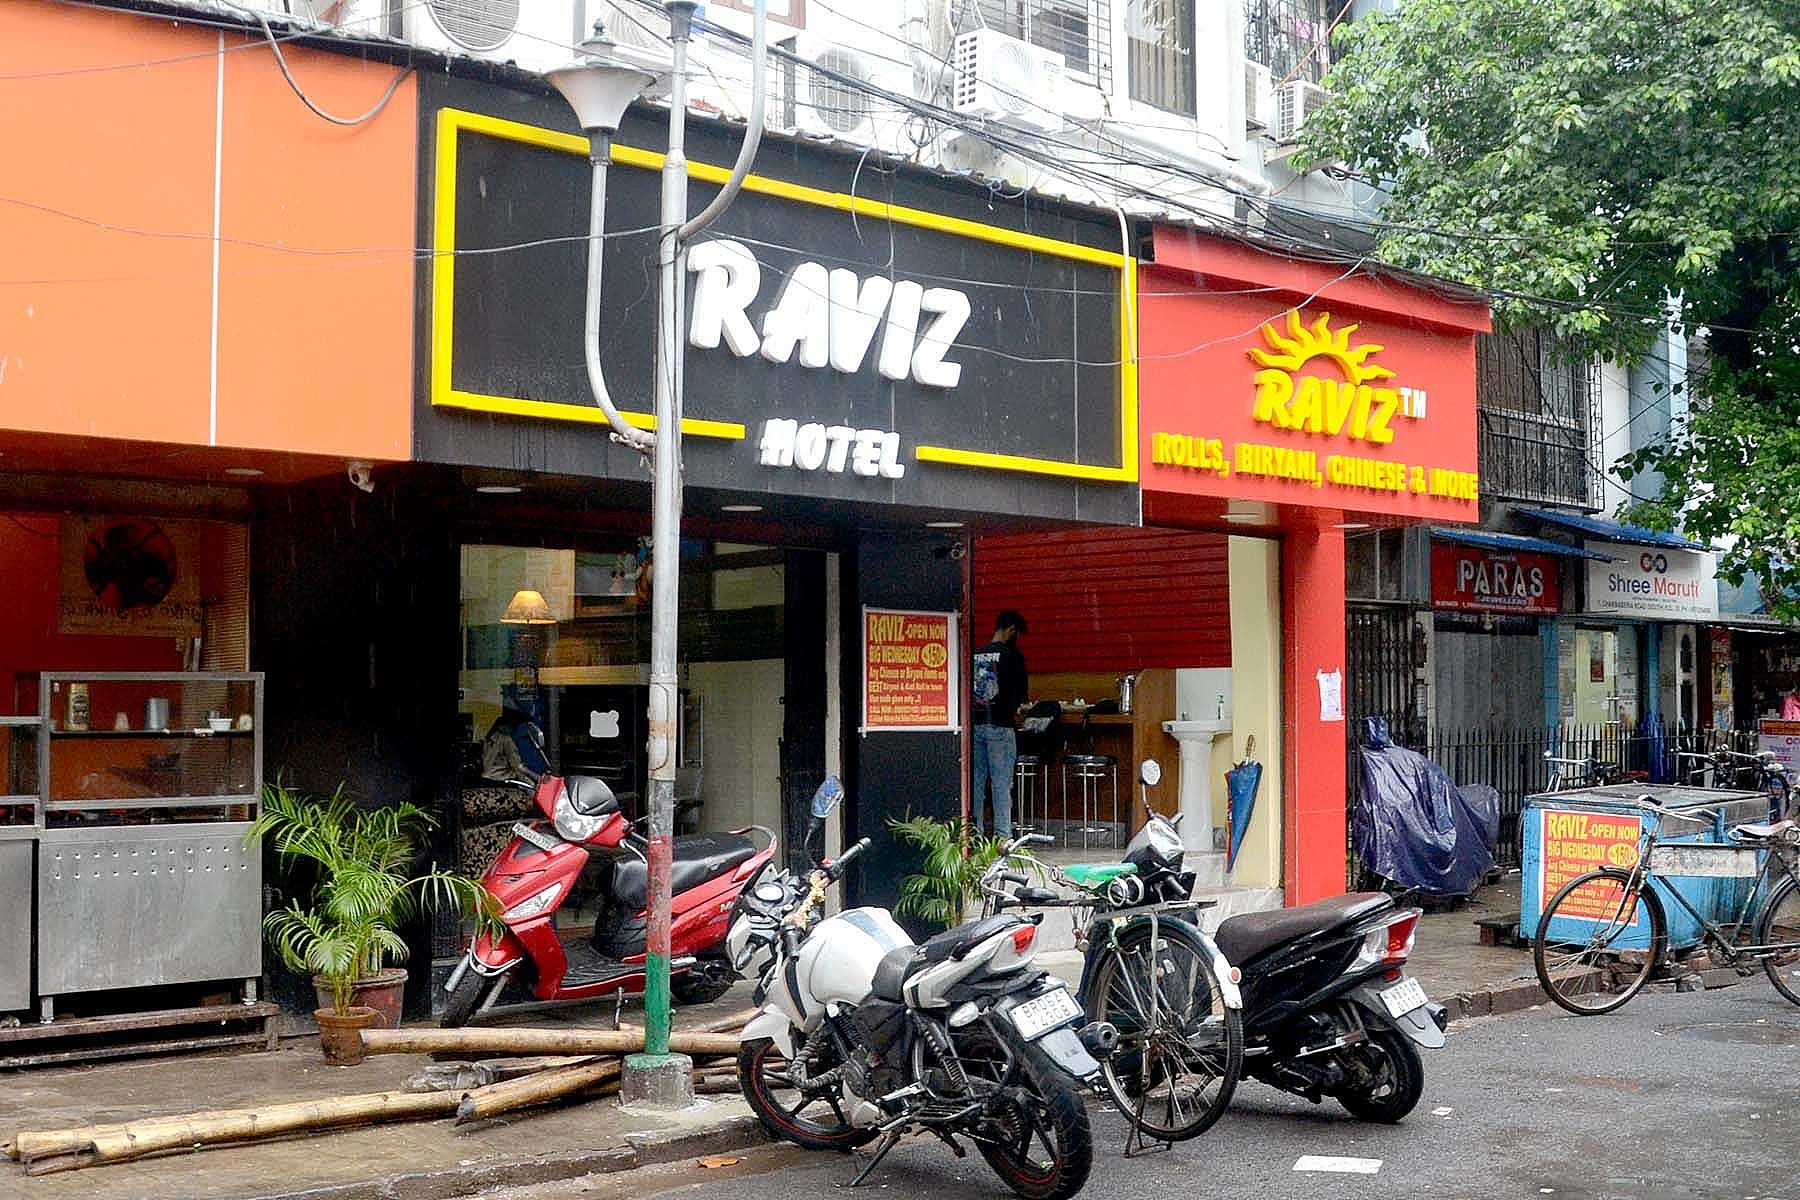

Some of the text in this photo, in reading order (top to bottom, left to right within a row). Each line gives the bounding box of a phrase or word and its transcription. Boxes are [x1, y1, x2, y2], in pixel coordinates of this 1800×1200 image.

[687, 239, 971, 389] RAVIZ
[1253, 368, 1427, 443] RAVIZ TM
[759, 417, 905, 479] HOTEL
[1152, 431, 1479, 501] ROLLS, BIRYANI, CHINESE & MORE
[1457, 559, 1544, 597] PARAS
[1608, 573, 1699, 598] Shree Maruti
[869, 615, 904, 641] RAVIZ
[929, 624, 946, 640] NOW
[881, 644, 920, 664] WEDNESDAY
[1548, 814, 1588, 840] RAVIZ
[1618, 825, 1639, 841] NOW
[1547, 840, 1561, 857] BIG
[1562, 842, 1606, 860] WEDNESDAY
